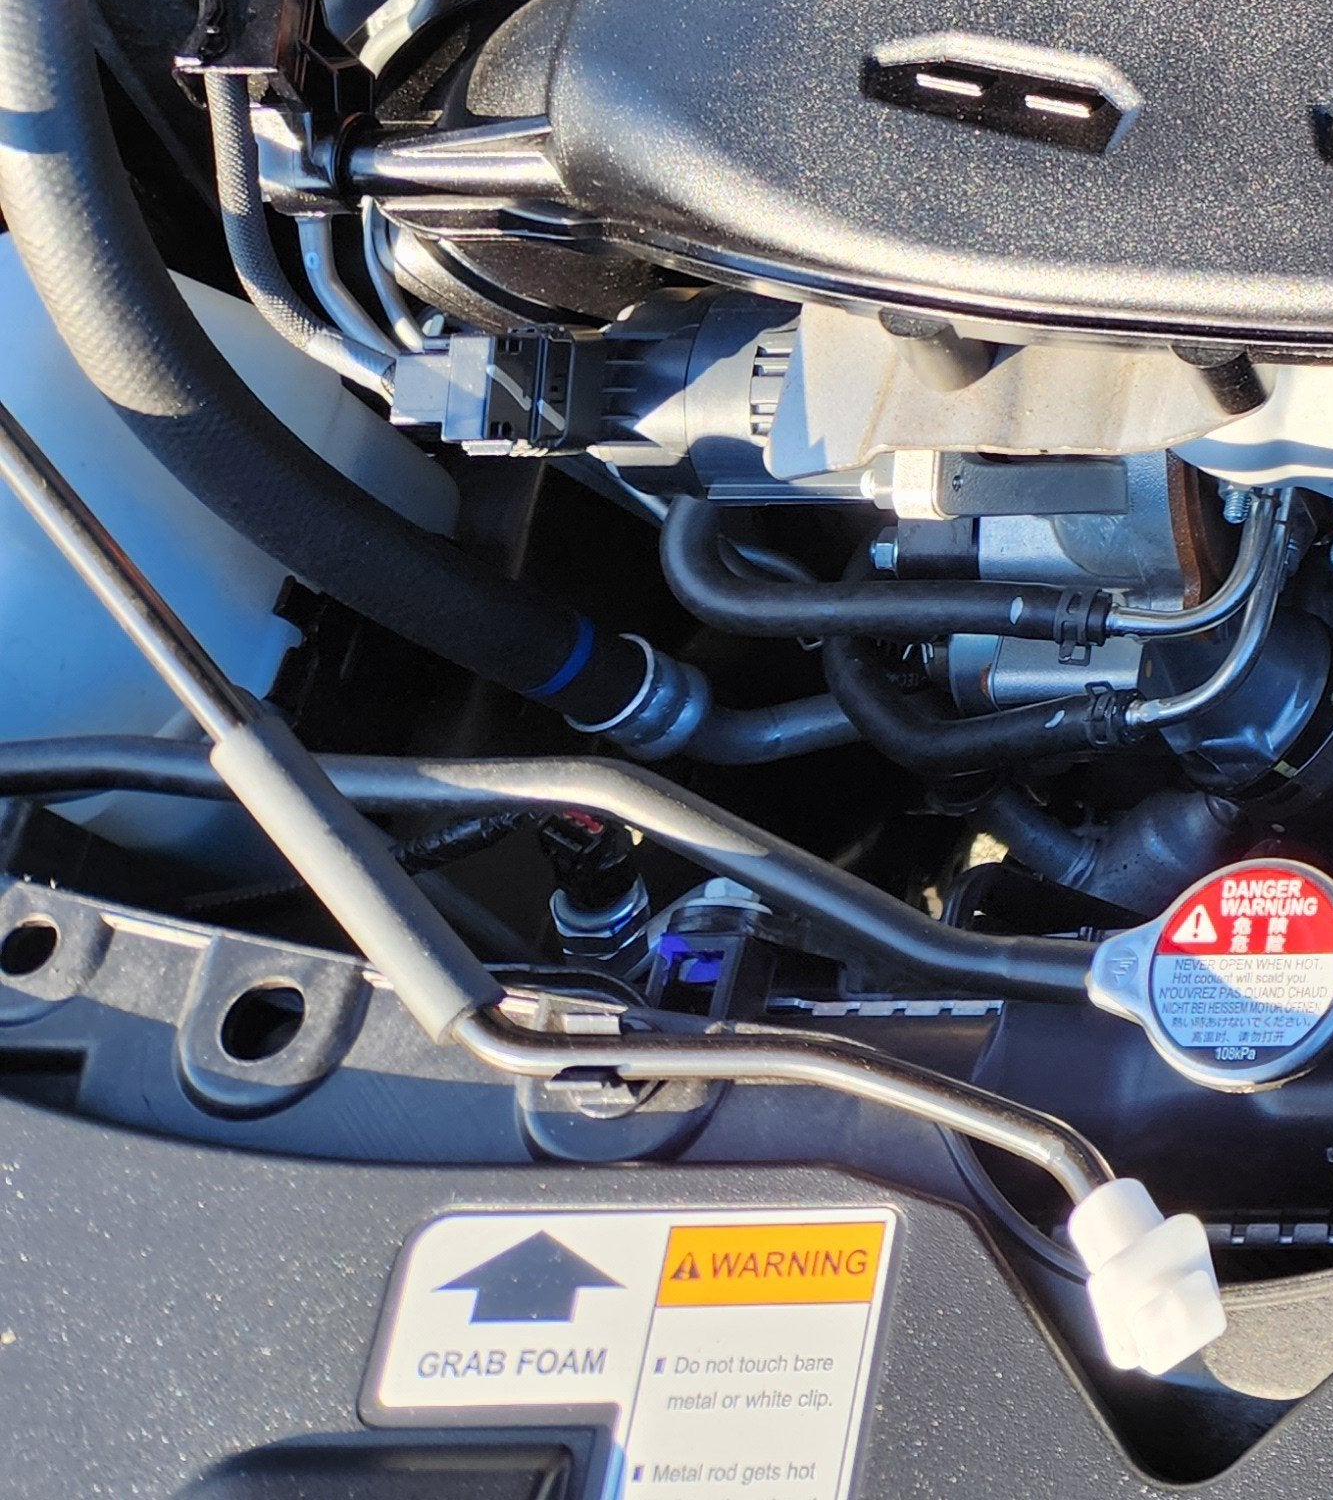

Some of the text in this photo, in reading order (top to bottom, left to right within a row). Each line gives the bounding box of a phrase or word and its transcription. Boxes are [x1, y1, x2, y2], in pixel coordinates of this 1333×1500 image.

[1221, 879, 1305, 898] DANGER
[1220, 897, 1319, 917] WARNUNG
[1174, 958, 1215, 971] NEVER
[1219, 958, 1254, 971] OPEN
[1256, 958, 1292, 971] WHEN
[1172, 973, 1194, 985] Hot
[1236, 973, 1253, 985] will
[1254, 973, 1285, 985] scald
[1159, 986, 1328, 1000] N'OUVREZ PAS QUAND CHAUD
[1161, 1002, 1190, 1015] NICHT
[1191, 1002, 1208, 1015] BEI
[1208, 1002, 1248, 1015] HEISSEM
[1249, 1002, 1284, 1015] MOTOR
[1214, 1047, 1257, 1061] 108kPa
[711, 1249, 869, 1279] WARNING
[417, 1347, 607, 1379] GRAB FOAM
[674, 1354, 834, 1375] Do not touch bare
[666, 1389, 833, 1412] metal or white clip.
[652, 1463, 816, 1486] Metal rod gets hot
